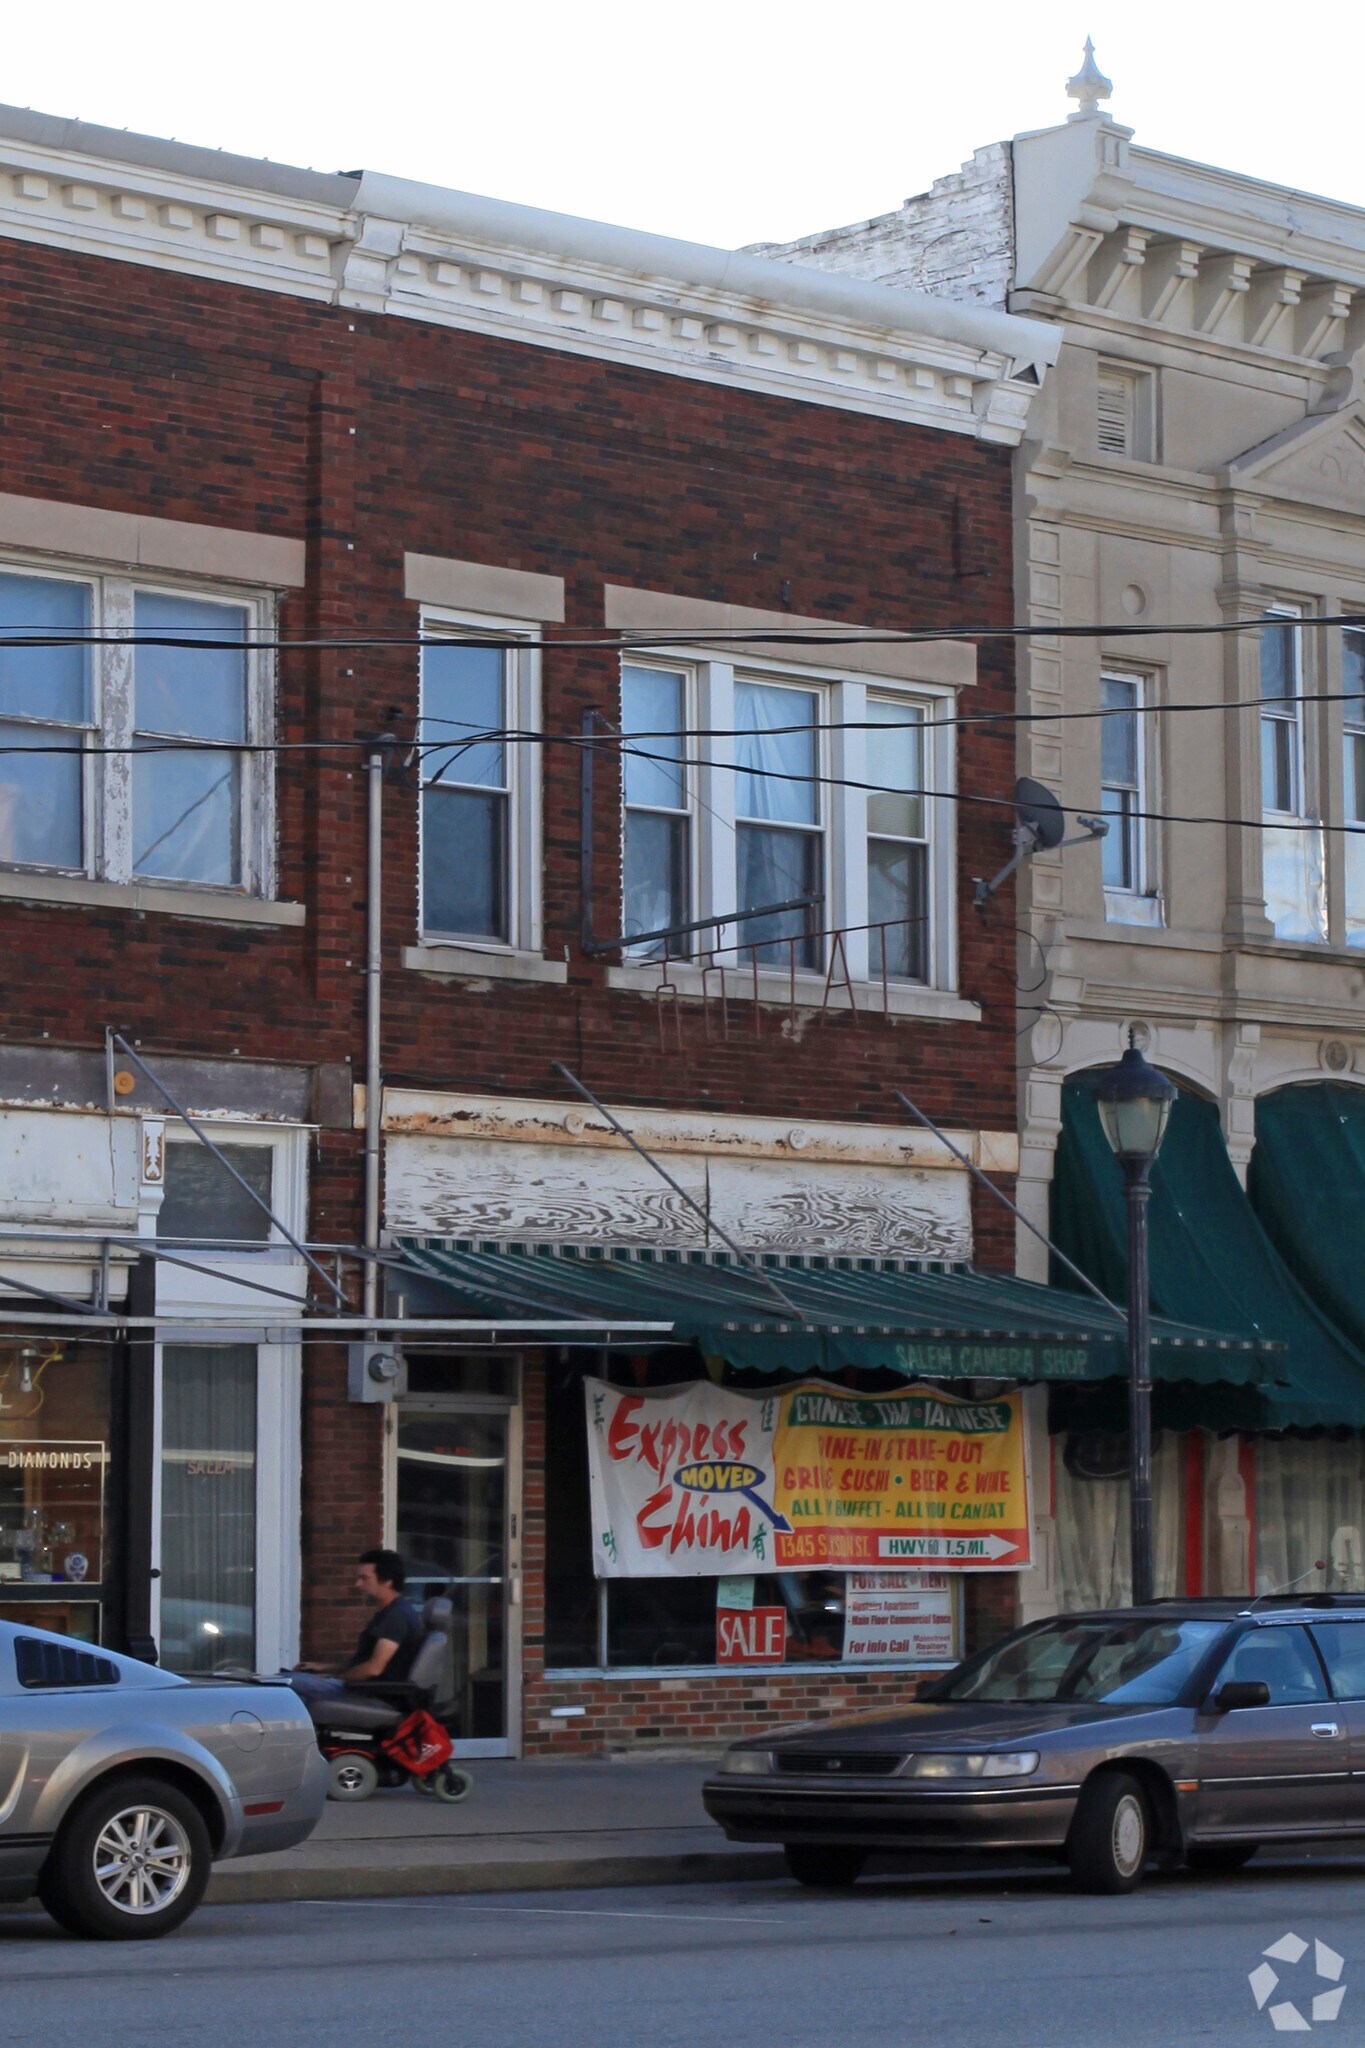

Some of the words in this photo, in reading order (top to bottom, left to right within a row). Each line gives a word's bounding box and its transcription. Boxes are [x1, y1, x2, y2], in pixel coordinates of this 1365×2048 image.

[896, 1344, 953, 1373] SALEM
[958, 1346, 1036, 1375] CAMERA
[607, 1394, 749, 1488] Express
[8, 1452, 92, 1469] DIAMONDS
[187, 1461, 235, 1475] SALEM
[680, 1464, 757, 1491] MOVED
[839, 1467, 891, 1493] SUSHI
[955, 1471, 970, 1494] &
[636, 1483, 751, 1554] China
[791, 1499, 824, 1517] ALL
[895, 1501, 924, 1518] ALL
[780, 1534, 816, 1558] 1345
[946, 1540, 966, 1555] 1.5
[720, 1616, 782, 1656] SALE
[849, 1641, 865, 1653] For
[889, 1639, 910, 1653] Call
